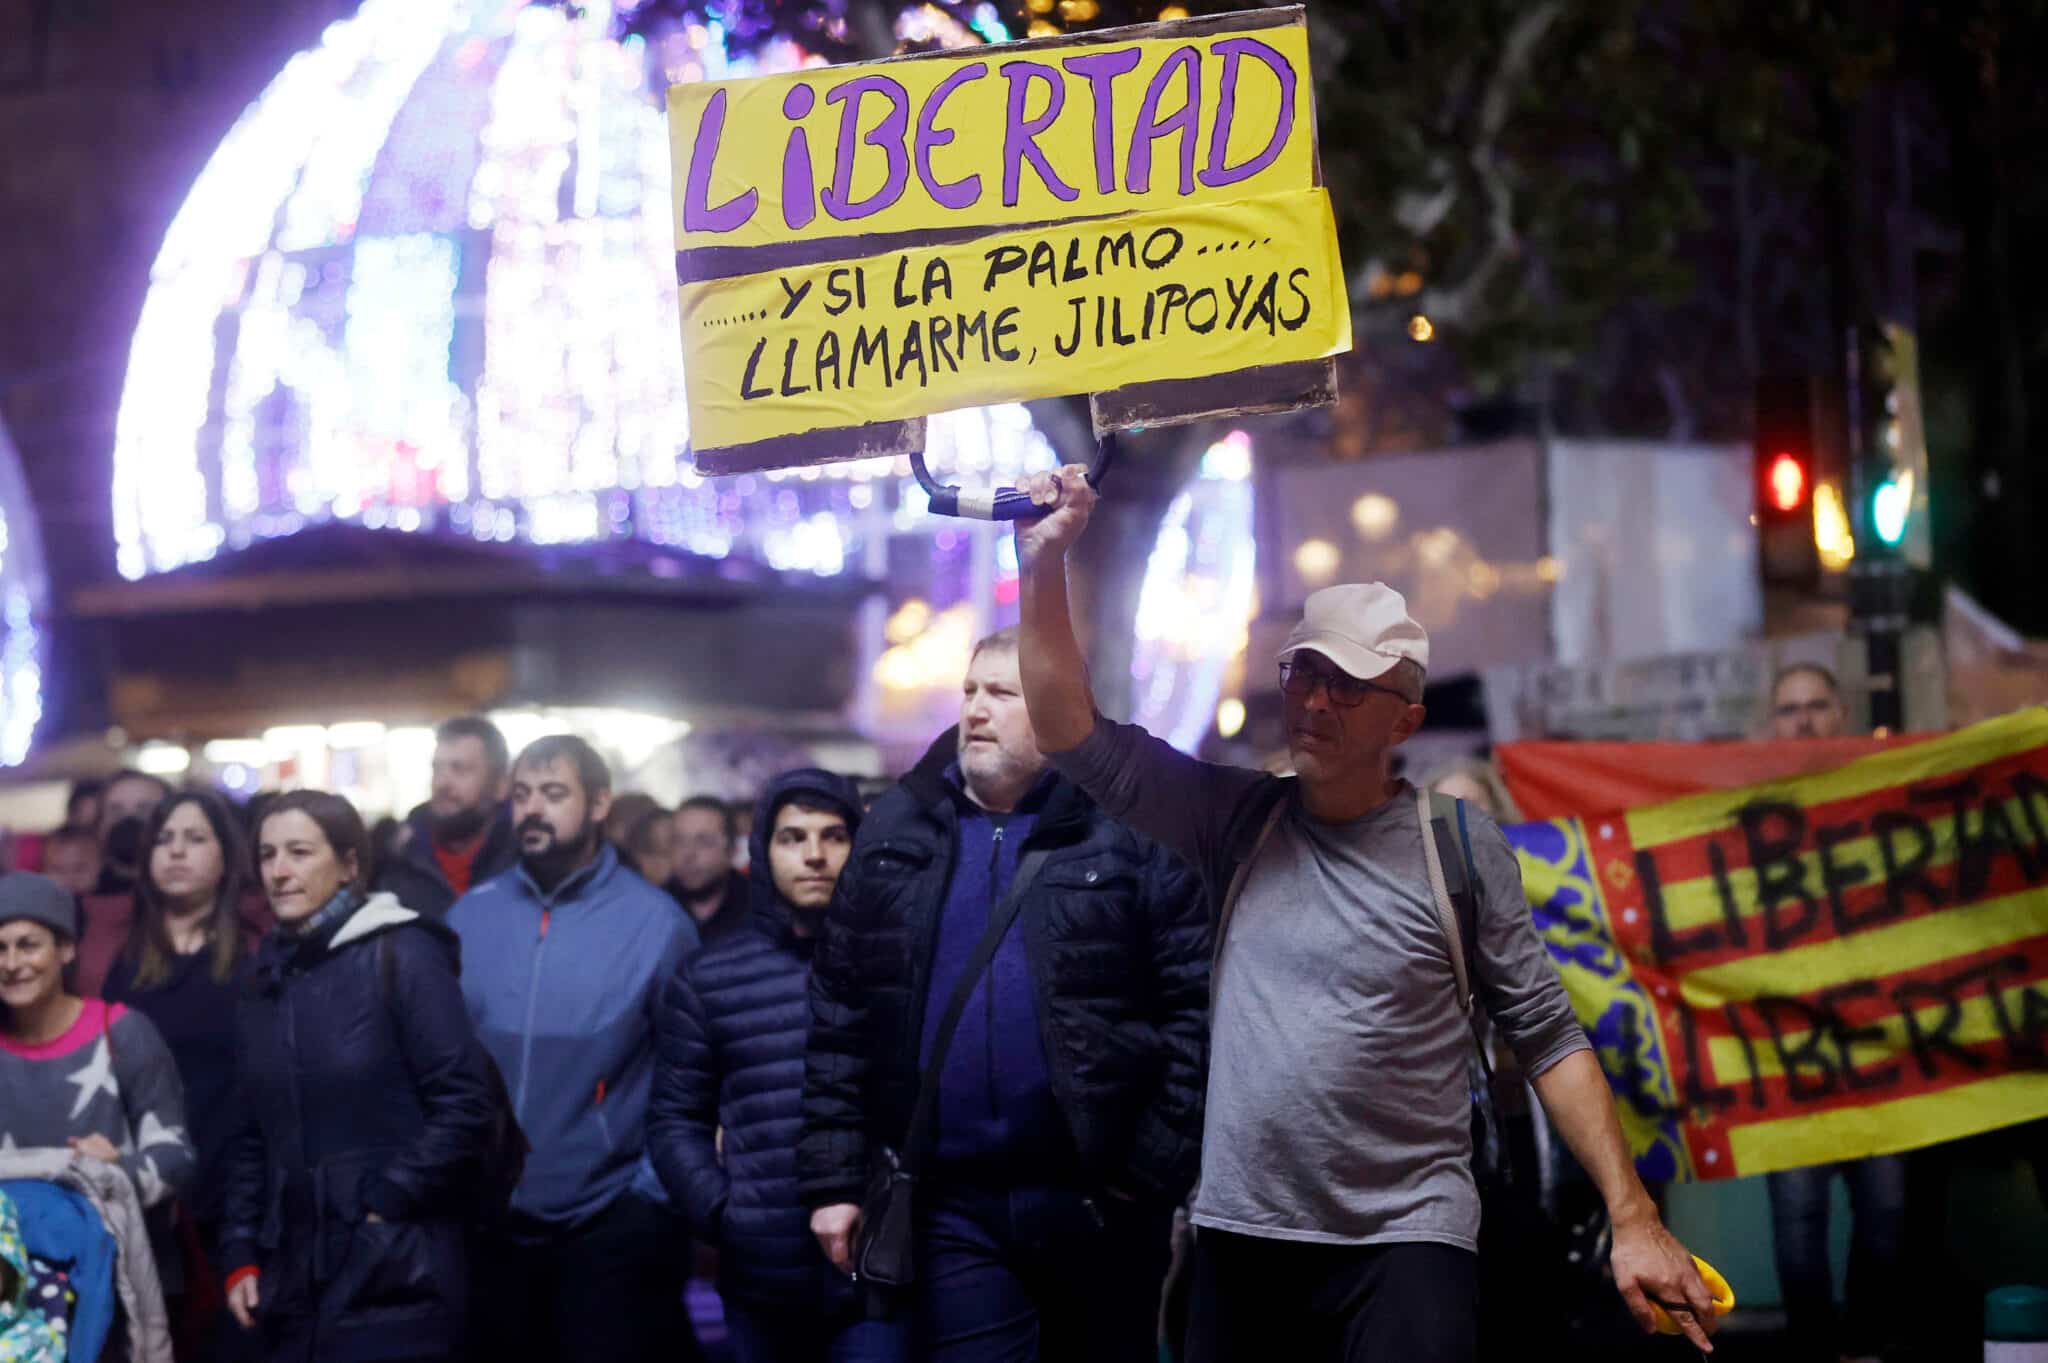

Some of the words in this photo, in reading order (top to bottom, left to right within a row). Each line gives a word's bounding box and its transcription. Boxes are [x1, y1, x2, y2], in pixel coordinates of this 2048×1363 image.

[893, 254, 953, 306] LA
[740, 307, 1037, 400] LLAMARME,
[1054, 267, 1311, 359] JILIPOYAS
